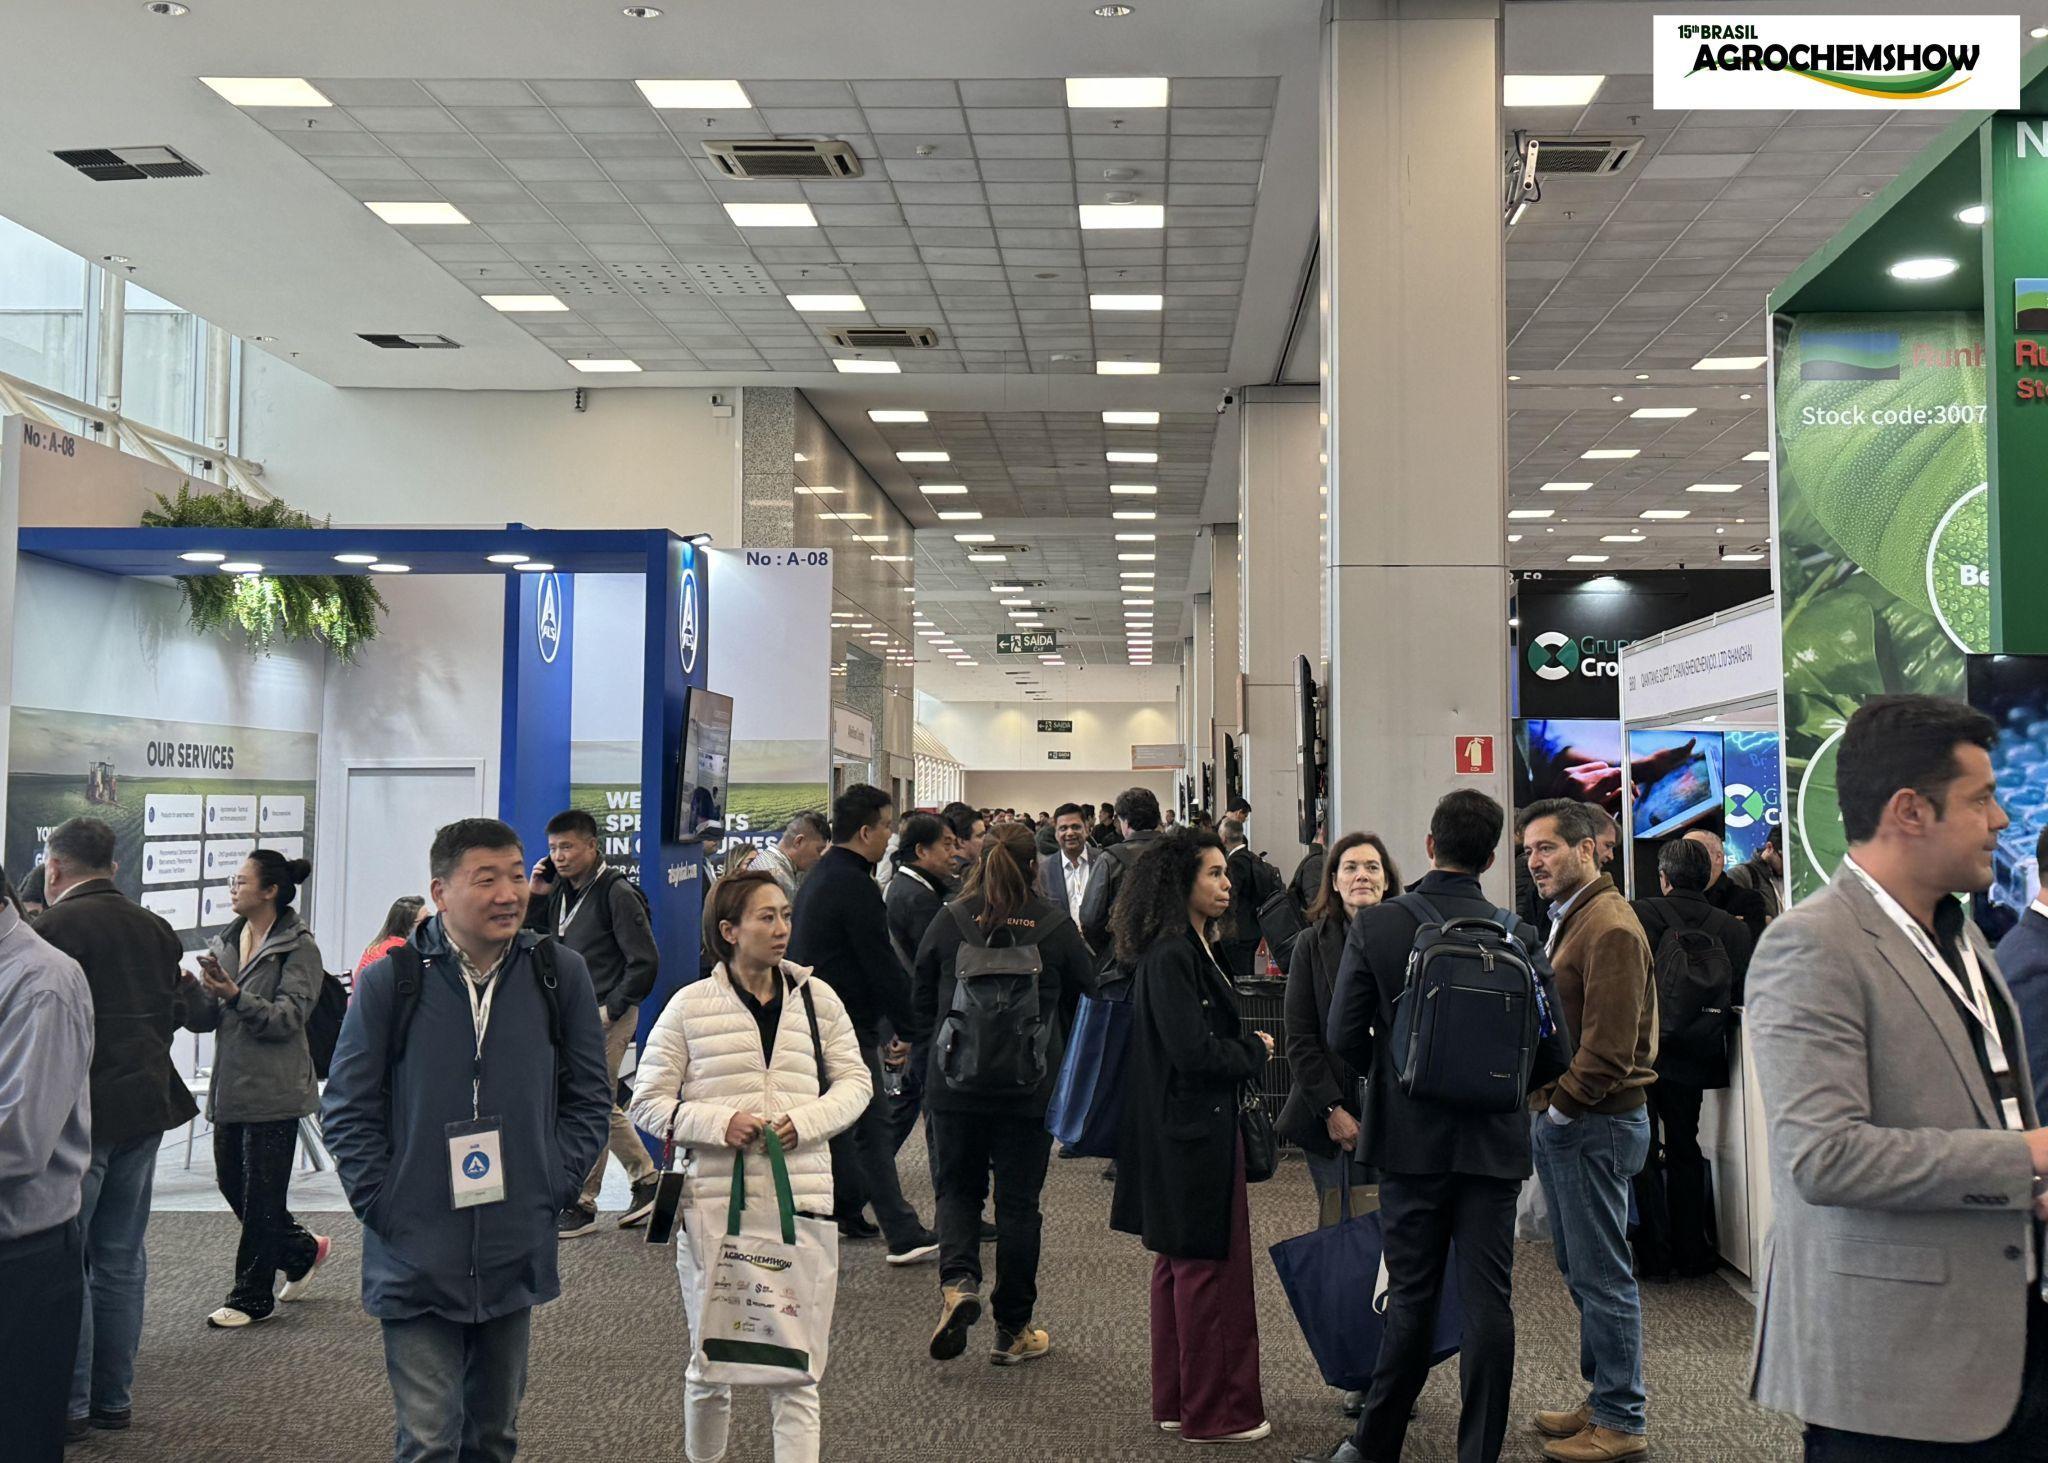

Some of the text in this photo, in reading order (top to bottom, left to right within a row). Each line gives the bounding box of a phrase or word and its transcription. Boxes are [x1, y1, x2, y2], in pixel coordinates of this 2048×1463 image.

[1802, 404, 1866, 425] Stock
[24, 423, 40, 448] No
[48, 431, 75, 458] A-08
[746, 551, 771, 566] No
[786, 551, 828, 566] A-08
[147, 741, 234, 769] OUR SERVICES
[605, 791, 641, 809] WE
[605, 837, 629, 854] IN
